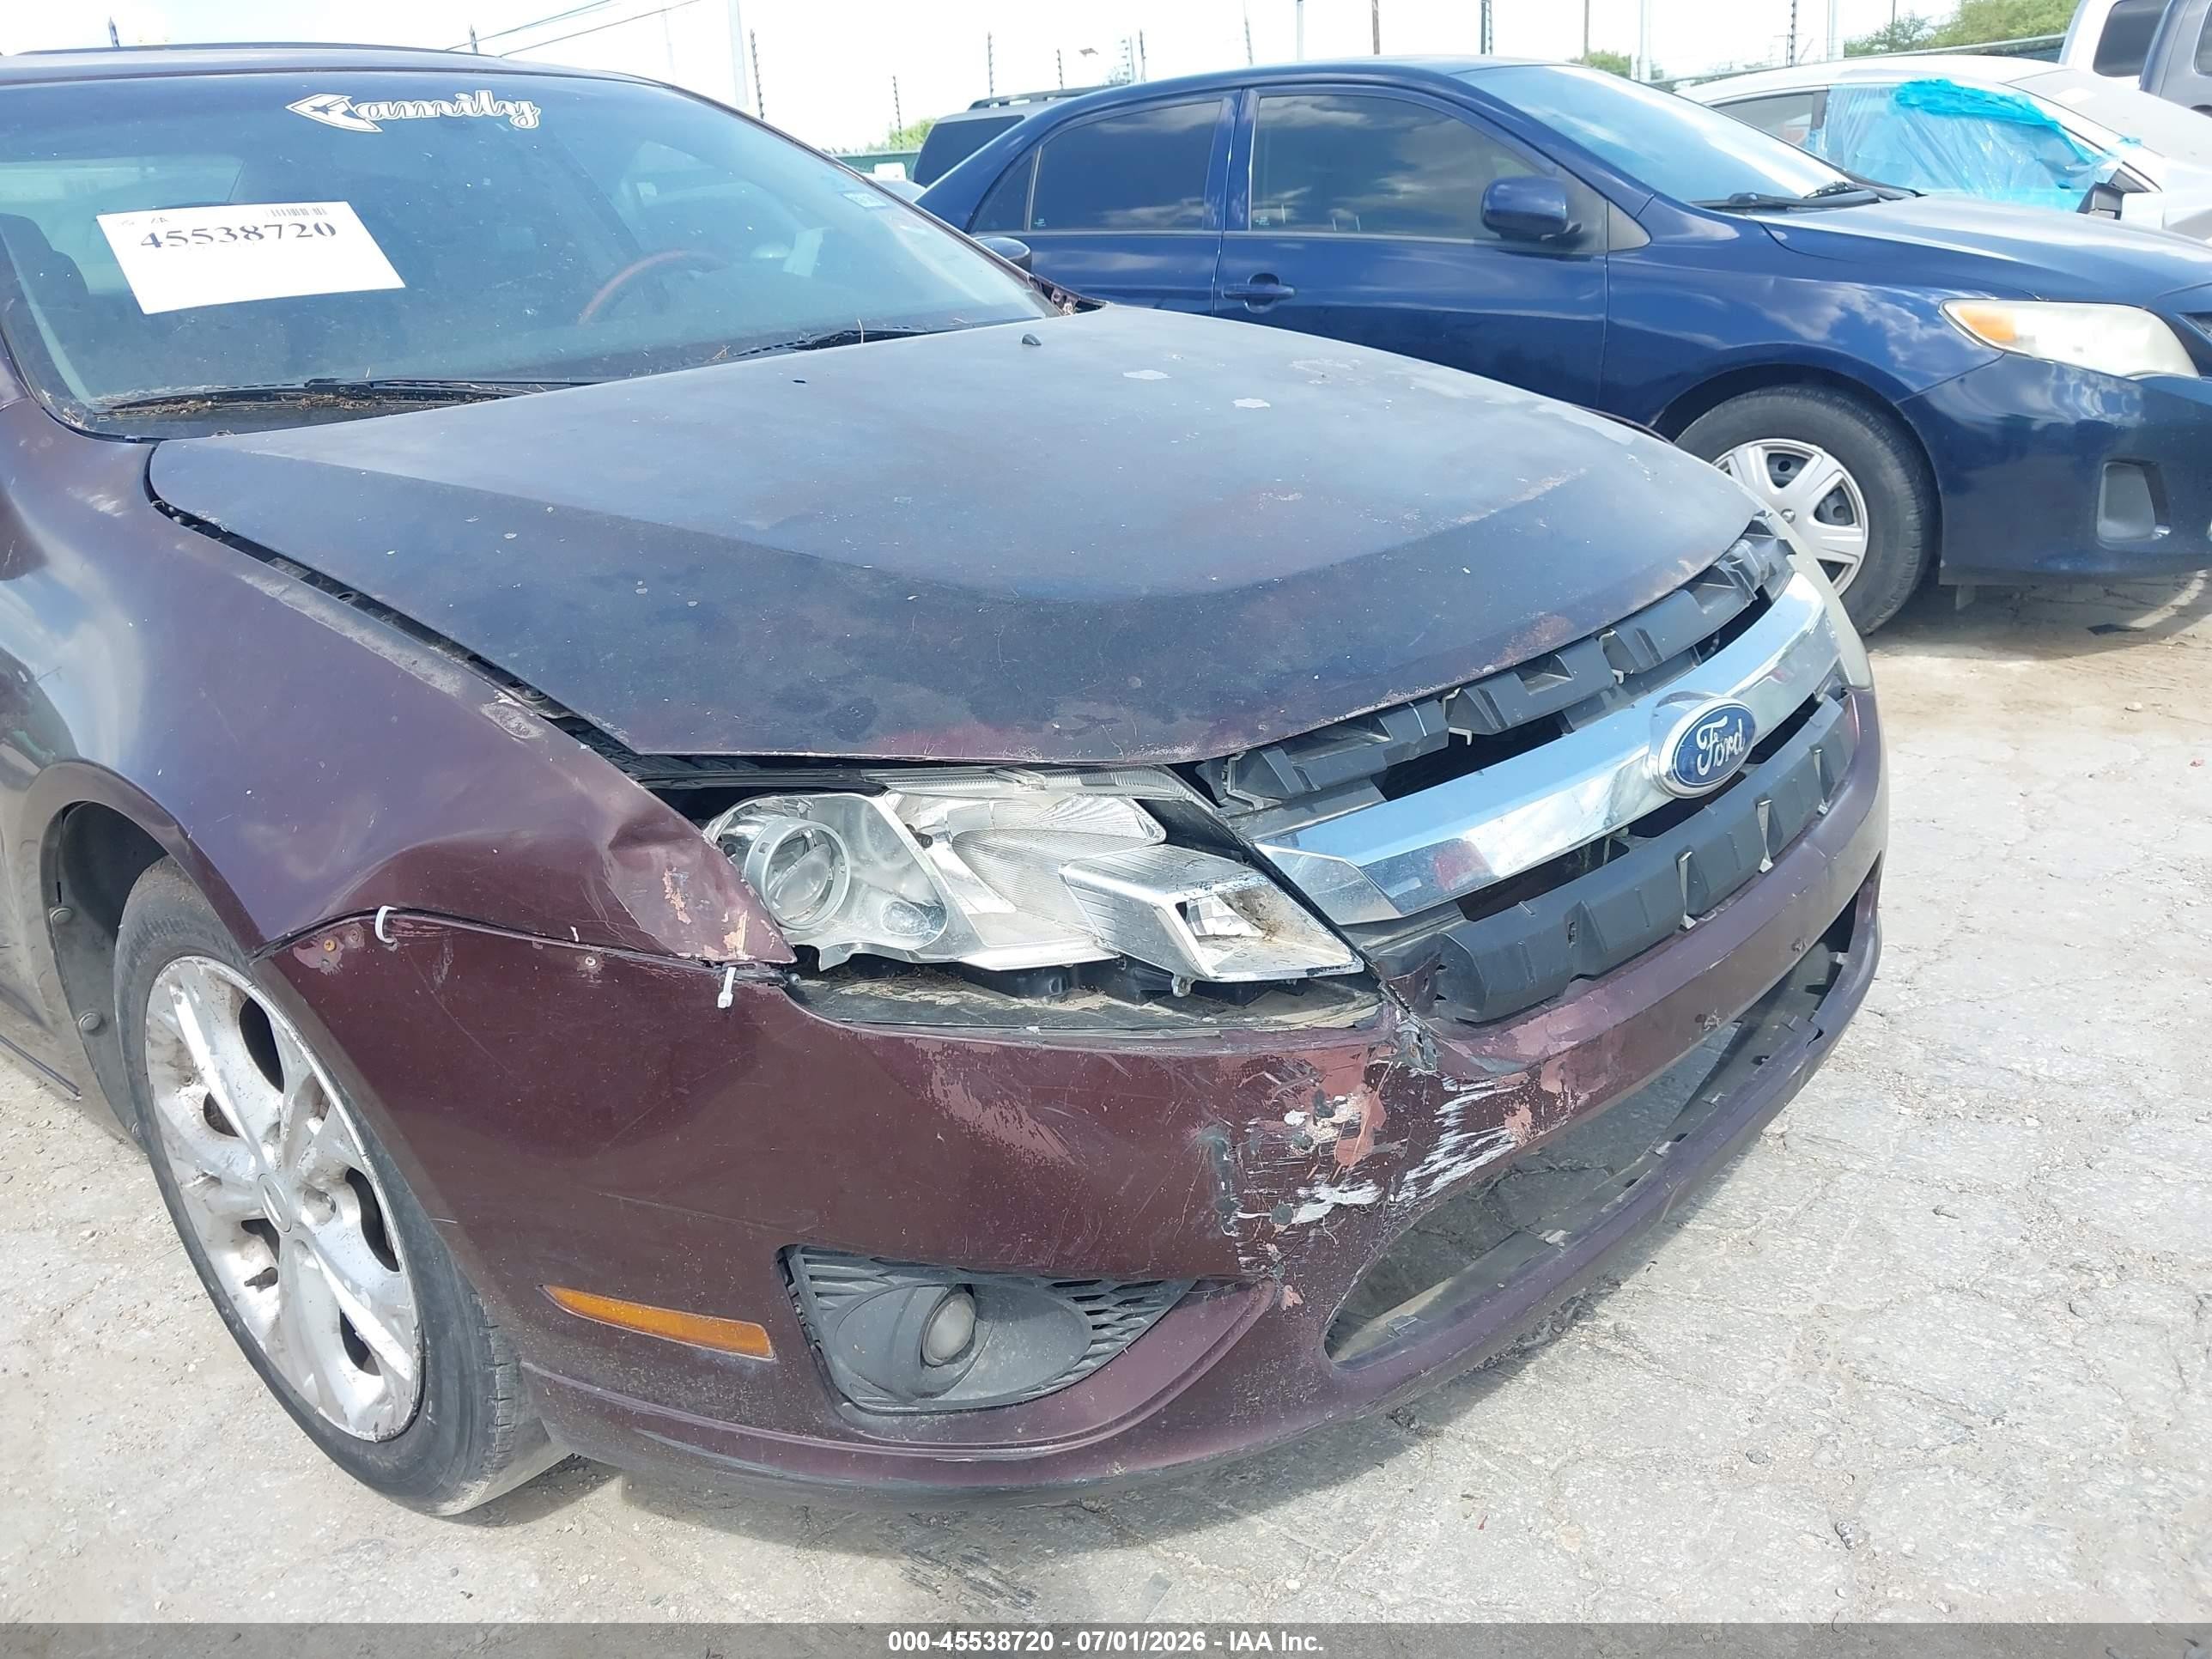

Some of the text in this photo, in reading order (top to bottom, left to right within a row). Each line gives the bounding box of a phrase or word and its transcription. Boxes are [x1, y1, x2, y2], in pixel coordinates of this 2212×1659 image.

[286, 90, 541, 132] Family
[141, 222, 336, 248] 45538720
[1696, 715, 1746, 776] Ford
